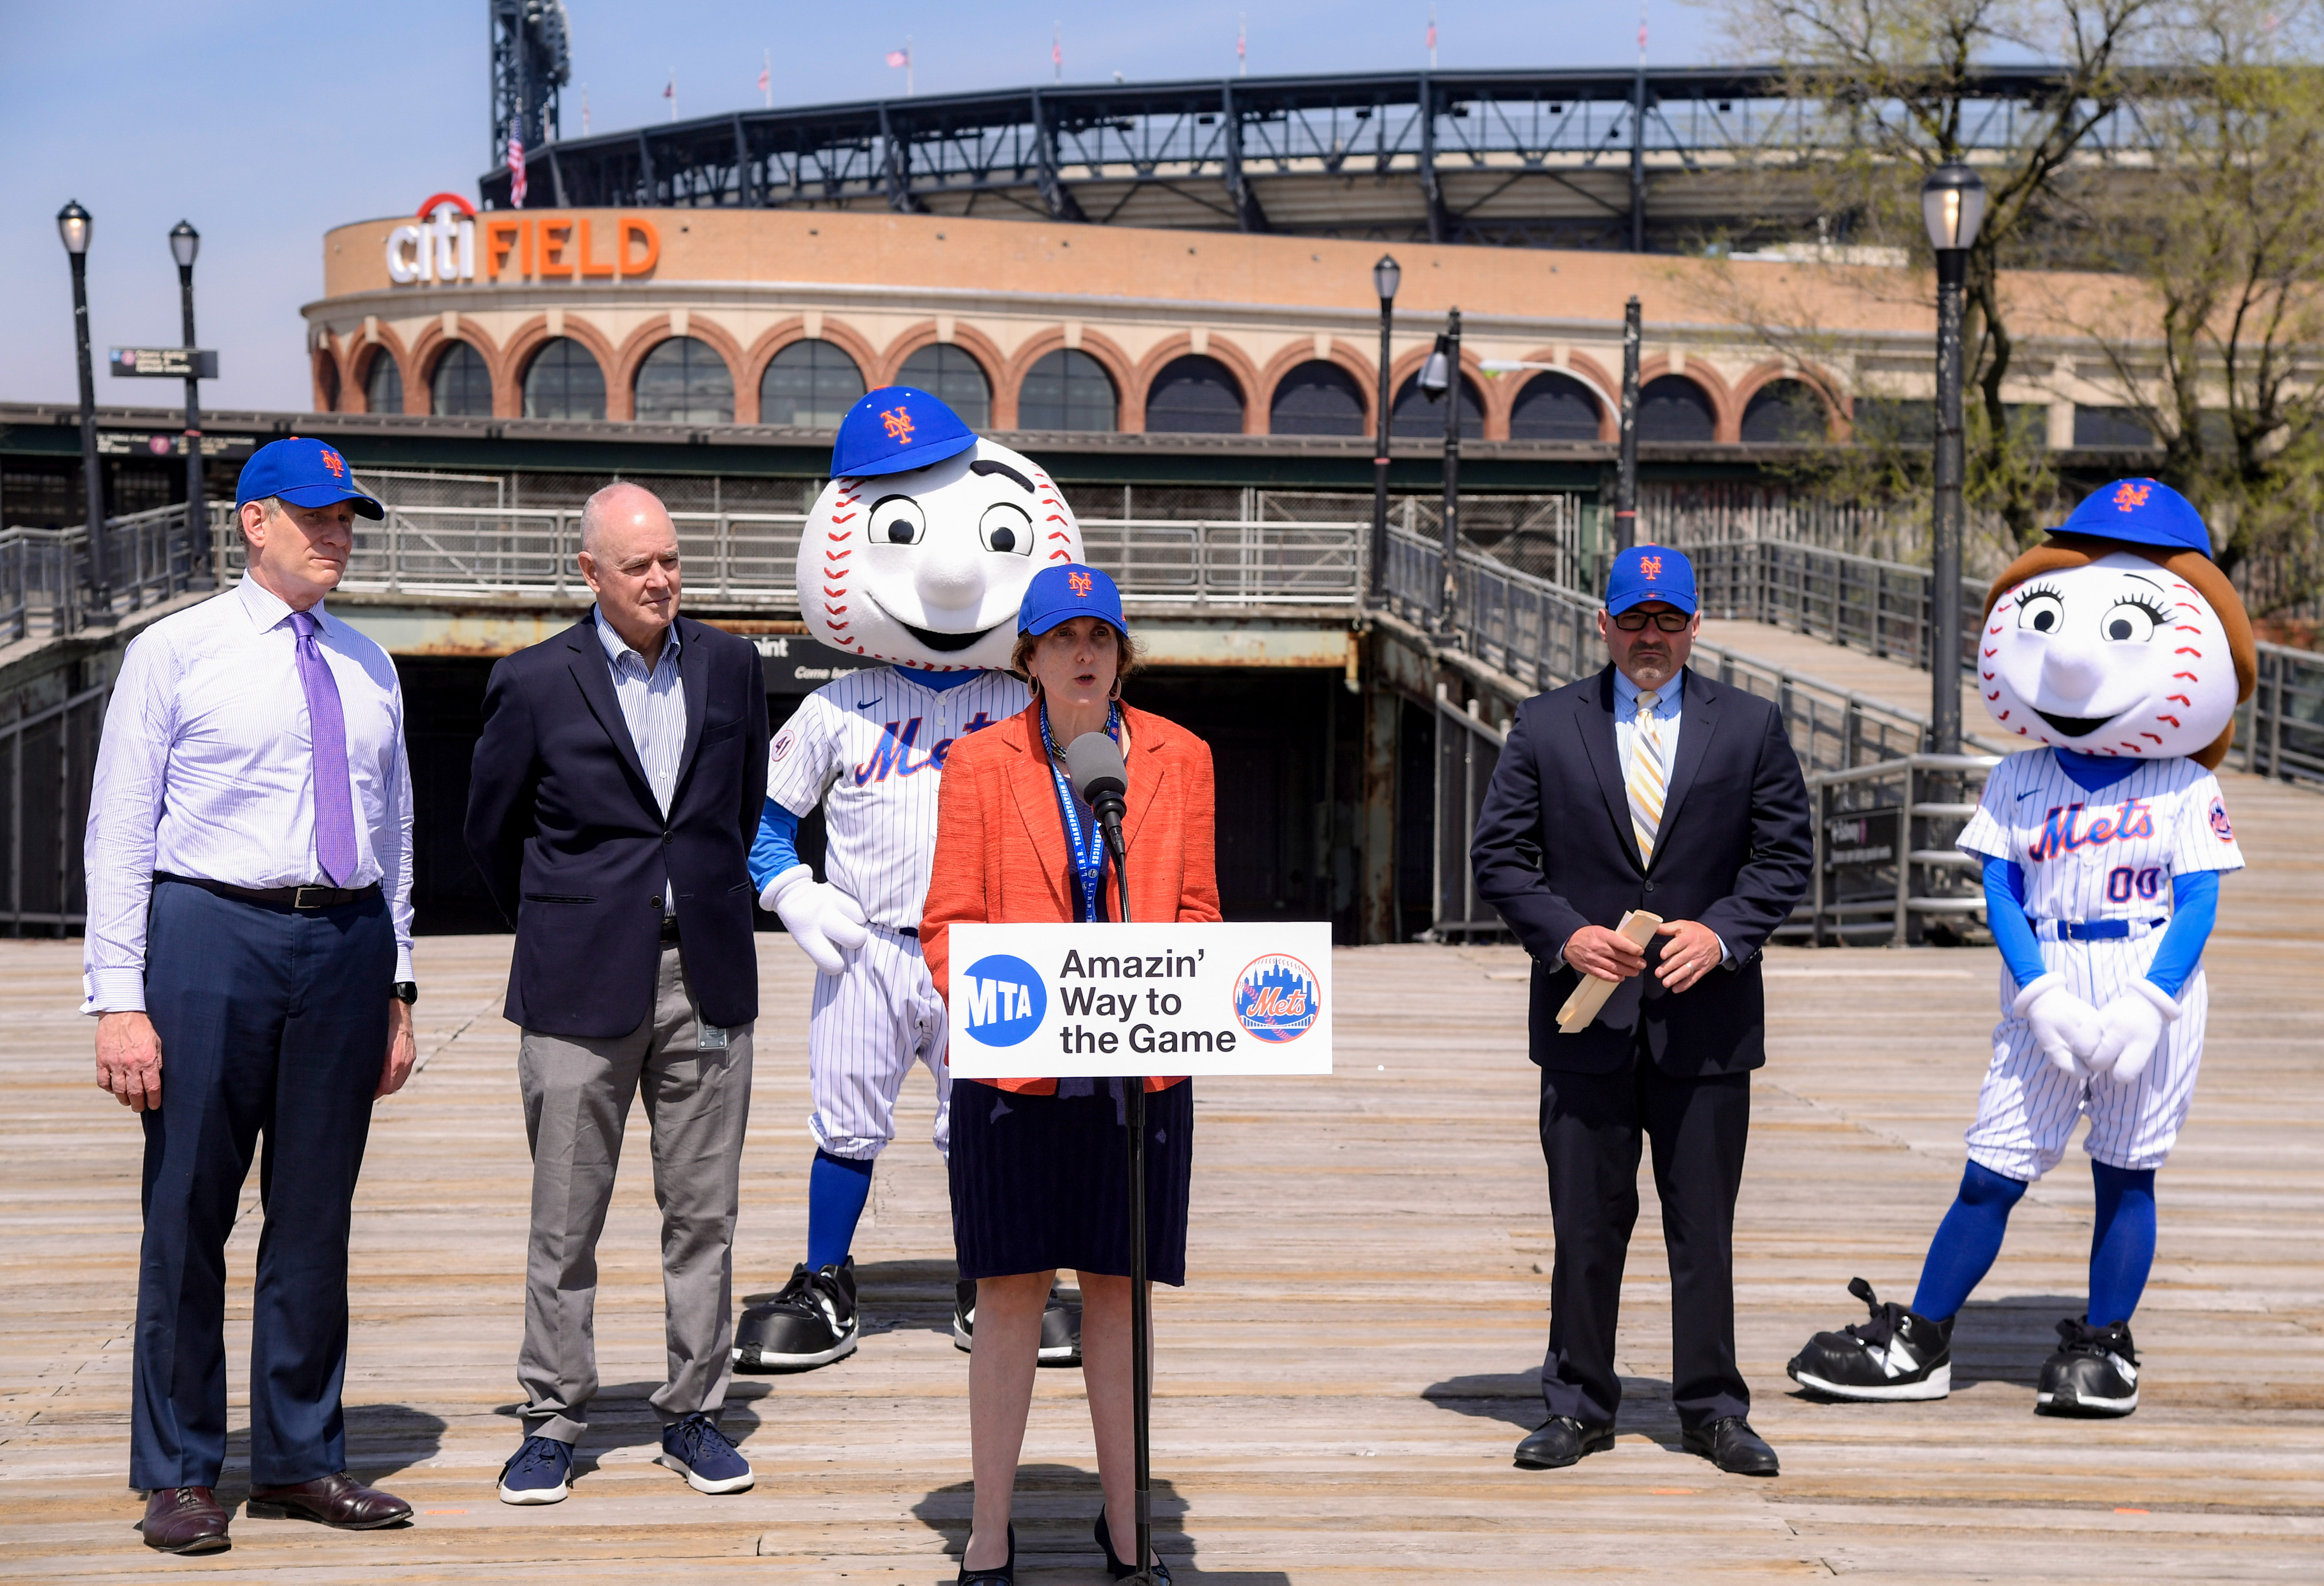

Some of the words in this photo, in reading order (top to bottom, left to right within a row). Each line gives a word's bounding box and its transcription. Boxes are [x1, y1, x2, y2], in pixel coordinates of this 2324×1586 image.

[386, 202, 475, 284] citi
[486, 218, 660, 277] FIELD
[880, 406, 916, 444] NY
[321, 450, 344, 478] NY
[1068, 572, 1092, 597] NY
[1641, 556, 1662, 580] NY
[794, 665, 830, 679] Come
[775, 736, 792, 756] 41
[1060, 785, 1082, 846] TRANSPORTATION
[2029, 798, 2155, 862] Mets
[2107, 865, 2161, 904] 00
[963, 975, 1032, 1029] MTA
[1060, 987, 1137, 1022] Way
[1146, 988, 1182, 1015] to
[1246, 987, 1307, 1016] Mets
[1060, 1025, 1118, 1054] the
[1129, 1023, 1236, 1053] Game
